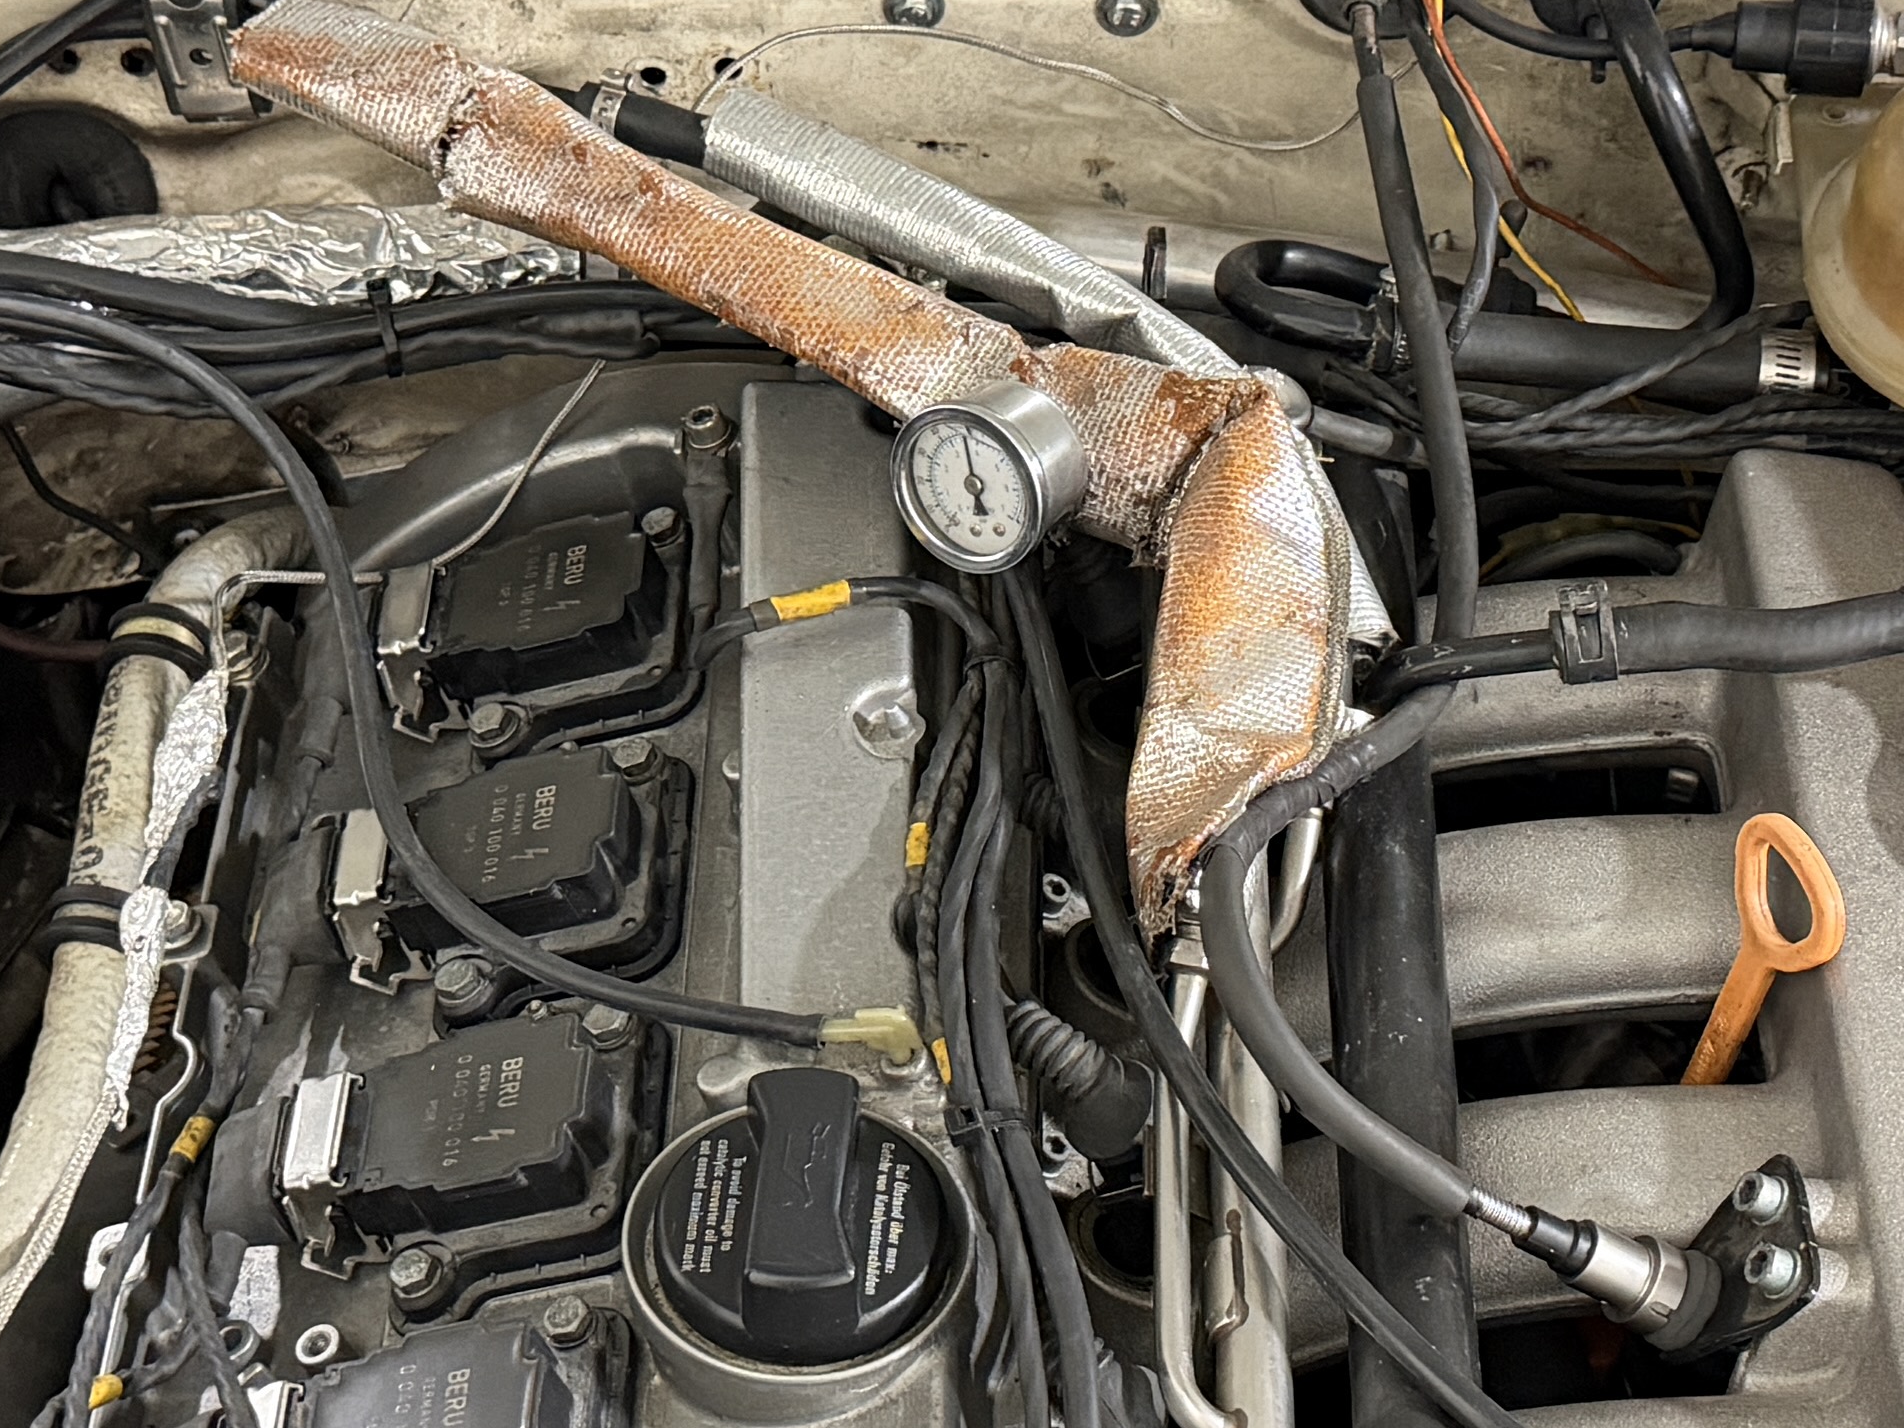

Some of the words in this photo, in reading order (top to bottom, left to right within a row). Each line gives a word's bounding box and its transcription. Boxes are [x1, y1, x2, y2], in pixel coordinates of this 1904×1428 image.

[564, 544, 587, 585] BERU
[490, 798, 507, 823] 040
[511, 793, 526, 835] GERMANY
[532, 785, 557, 831] BERU
[486, 828, 503, 853] 100
[482, 858, 499, 883] 016
[457, 1054, 473, 1064] 0
[476, 1064, 492, 1113] GERMANY
[497, 1056, 524, 1108] BERU
[442, 1137, 461, 1167] 016
[699, 1139, 712, 1156] not
[712, 1138, 729, 1178] catalytic
[732, 1156, 747, 1168] To
[878, 1142, 896, 1173] Gefahr
[693, 1156, 709, 1190] exceed
[728, 1169, 742, 1196] avoid
[876, 1174, 888, 1192] von
[706, 1179, 722, 1227] converter
[891, 1181, 911, 1220] Ölstand
[686, 1191, 704, 1241] maximum
[720, 1197, 741, 1238] damage
[704, 1228, 719, 1243] oil
[720, 1240, 733, 1252] to
[865, 1194, 889, 1296] Katalysatorschäden
[888, 1221, 904, 1244] über
[681, 1243, 696, 1273] mark
[699, 1244, 713, 1274] must
[400, 1364, 416, 1374] 0
[443, 1368, 471, 1427] BERU
